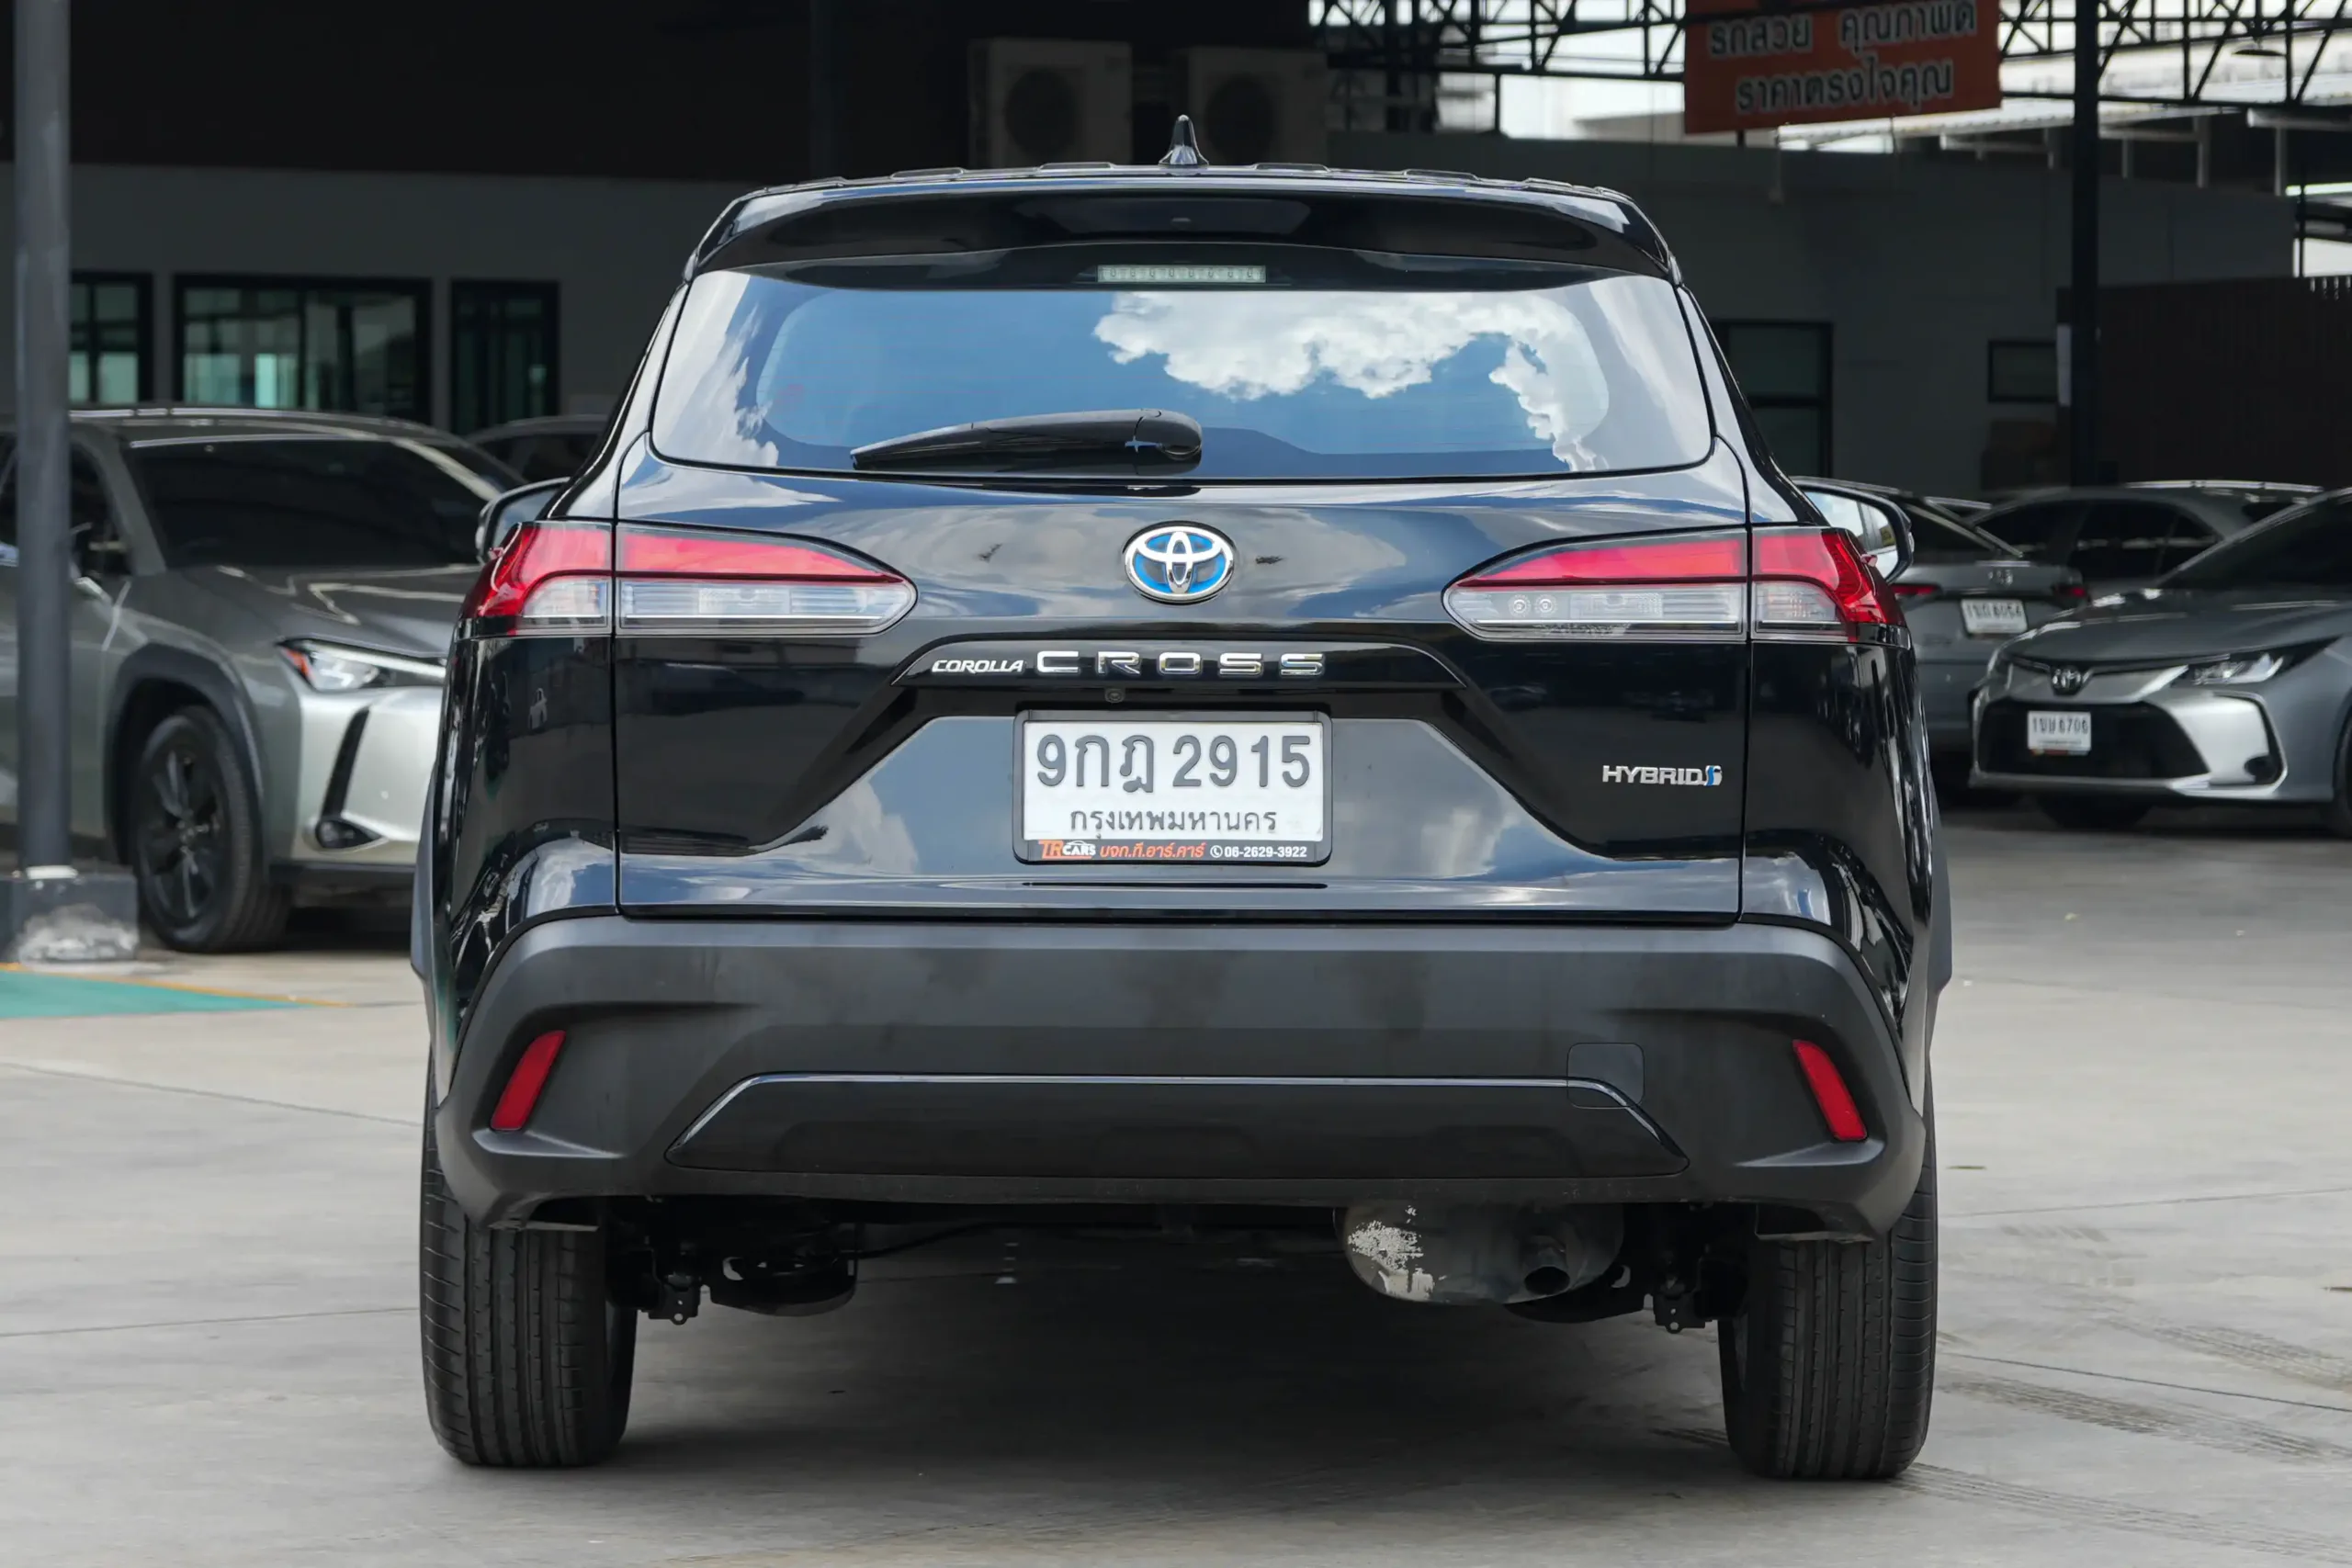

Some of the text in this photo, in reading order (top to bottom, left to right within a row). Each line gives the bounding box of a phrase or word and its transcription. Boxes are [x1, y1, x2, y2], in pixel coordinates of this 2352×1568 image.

[931, 650, 1326, 676] COROLLA CROSS
[1037, 734, 1310, 793] 9กฎ 2915
[1602, 765, 1703, 785] HYBRID
[1070, 810, 1277, 840] กรุงเทพมหานคร
[1038, 840, 1064, 859] TR
[1063, 843, 1096, 856] CARS
[1224, 846, 1307, 858] 06-2629-3922
